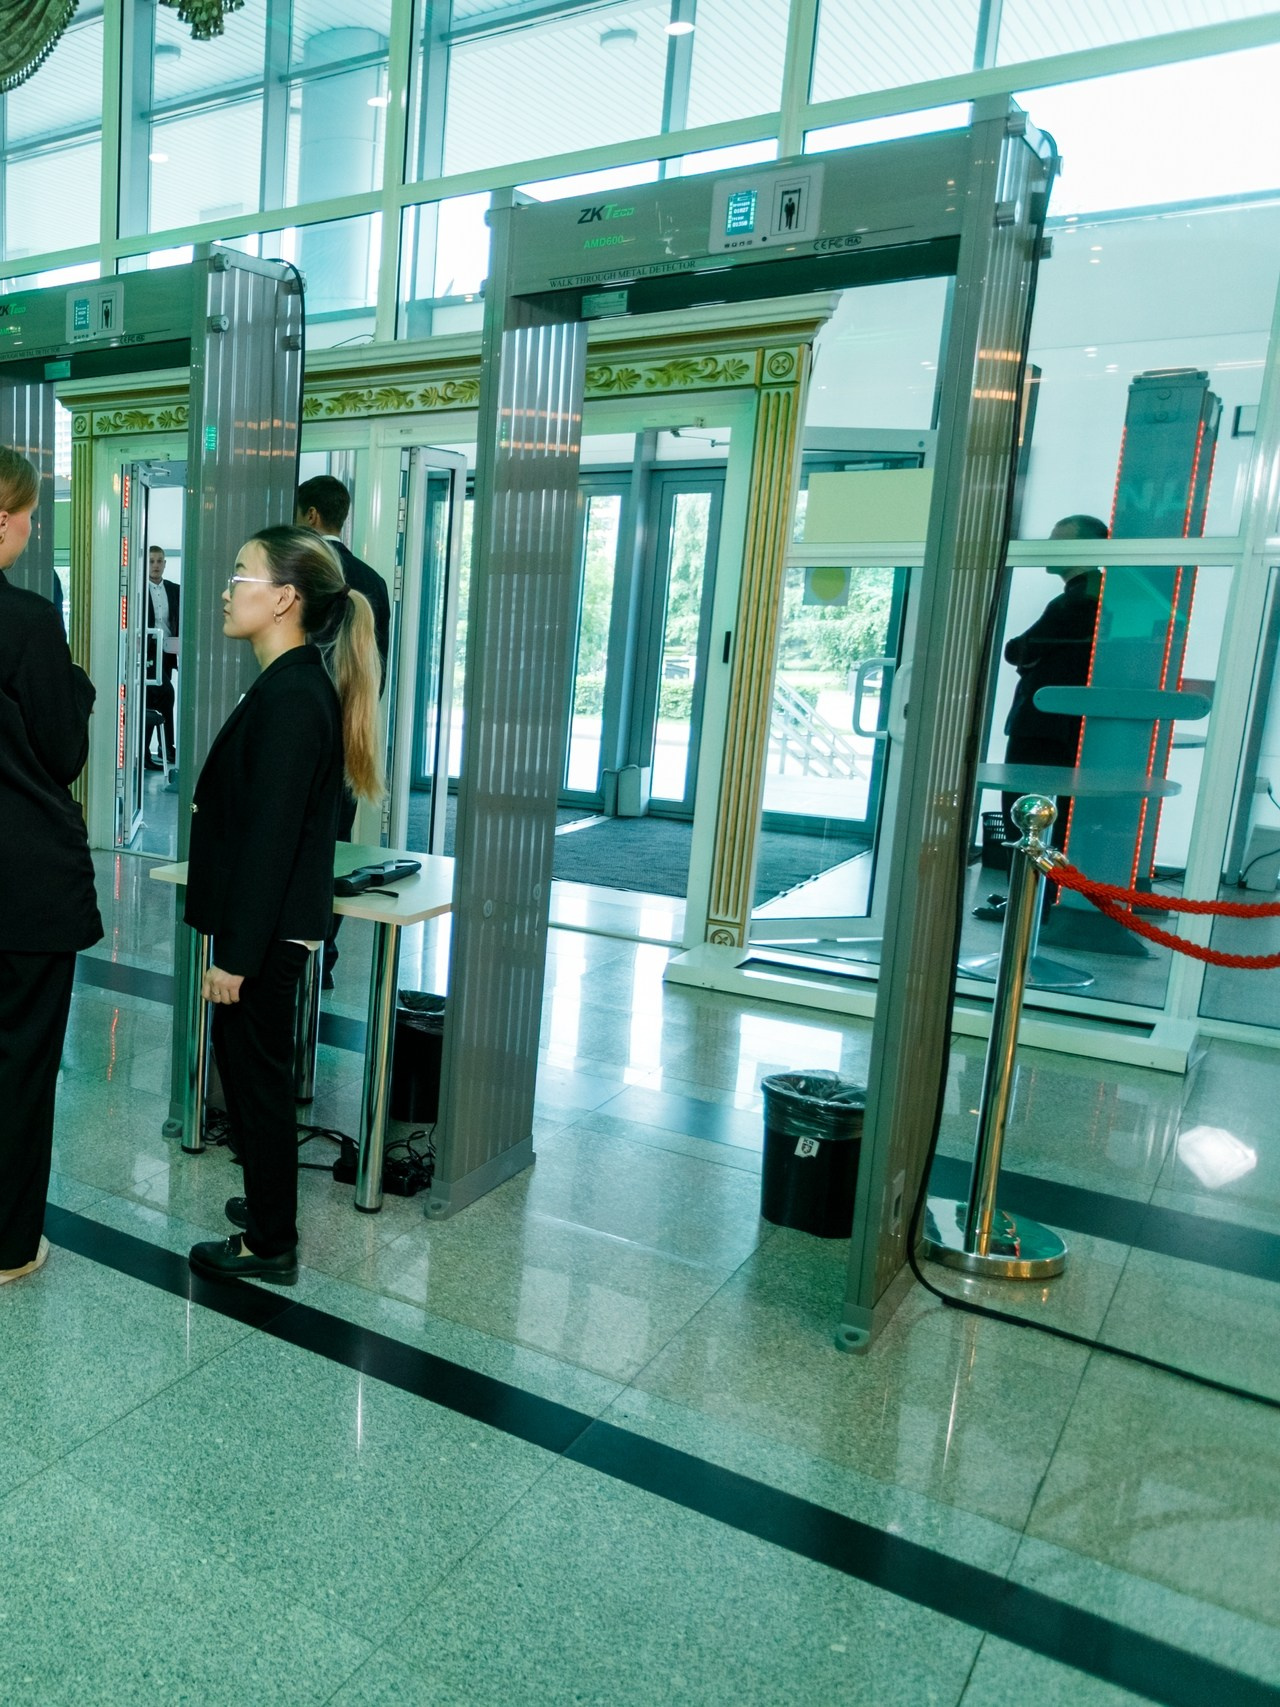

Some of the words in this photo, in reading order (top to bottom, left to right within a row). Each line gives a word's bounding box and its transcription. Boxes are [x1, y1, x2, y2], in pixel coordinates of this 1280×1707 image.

[583, 235, 624, 249] AMD600
[550, 279, 573, 288] WALK
[575, 272, 616, 285] THROUGH
[618, 267, 647, 280] METAL
[649, 260, 696, 274] DETECTOR
